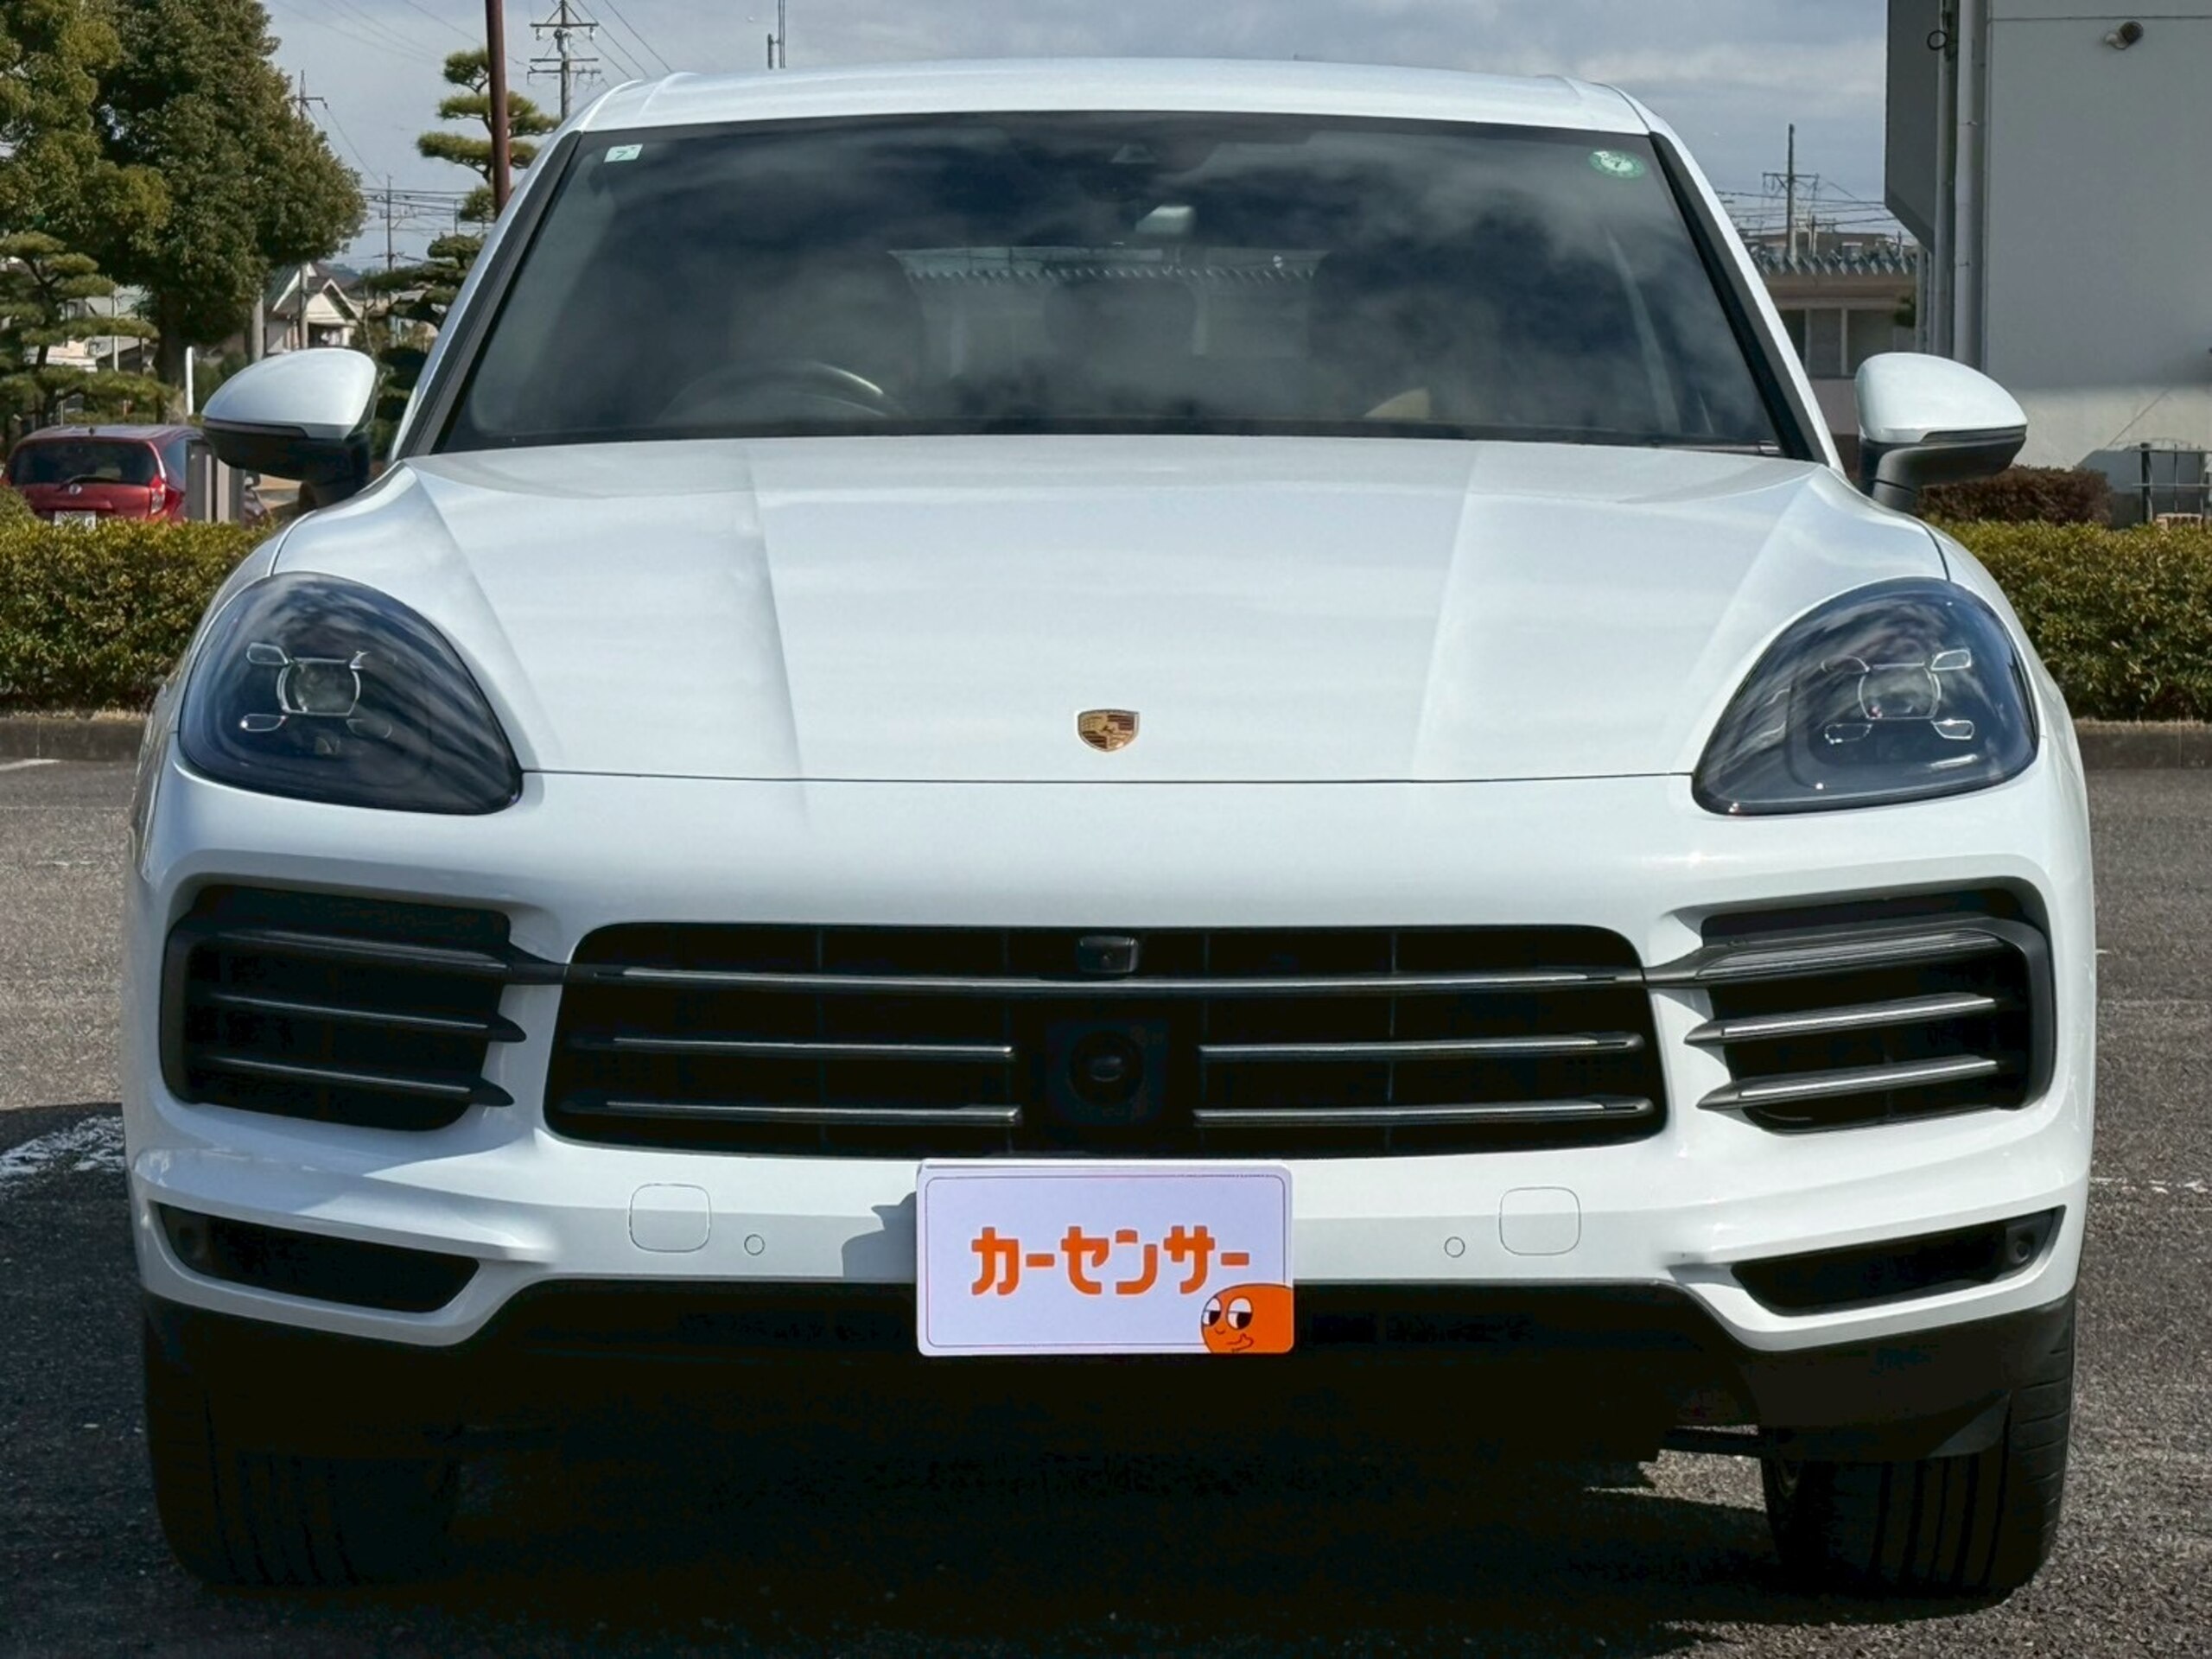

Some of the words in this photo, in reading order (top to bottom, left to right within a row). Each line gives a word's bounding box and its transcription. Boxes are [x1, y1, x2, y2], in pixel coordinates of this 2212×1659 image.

[970, 1224, 1251, 1295] カーセンサー
